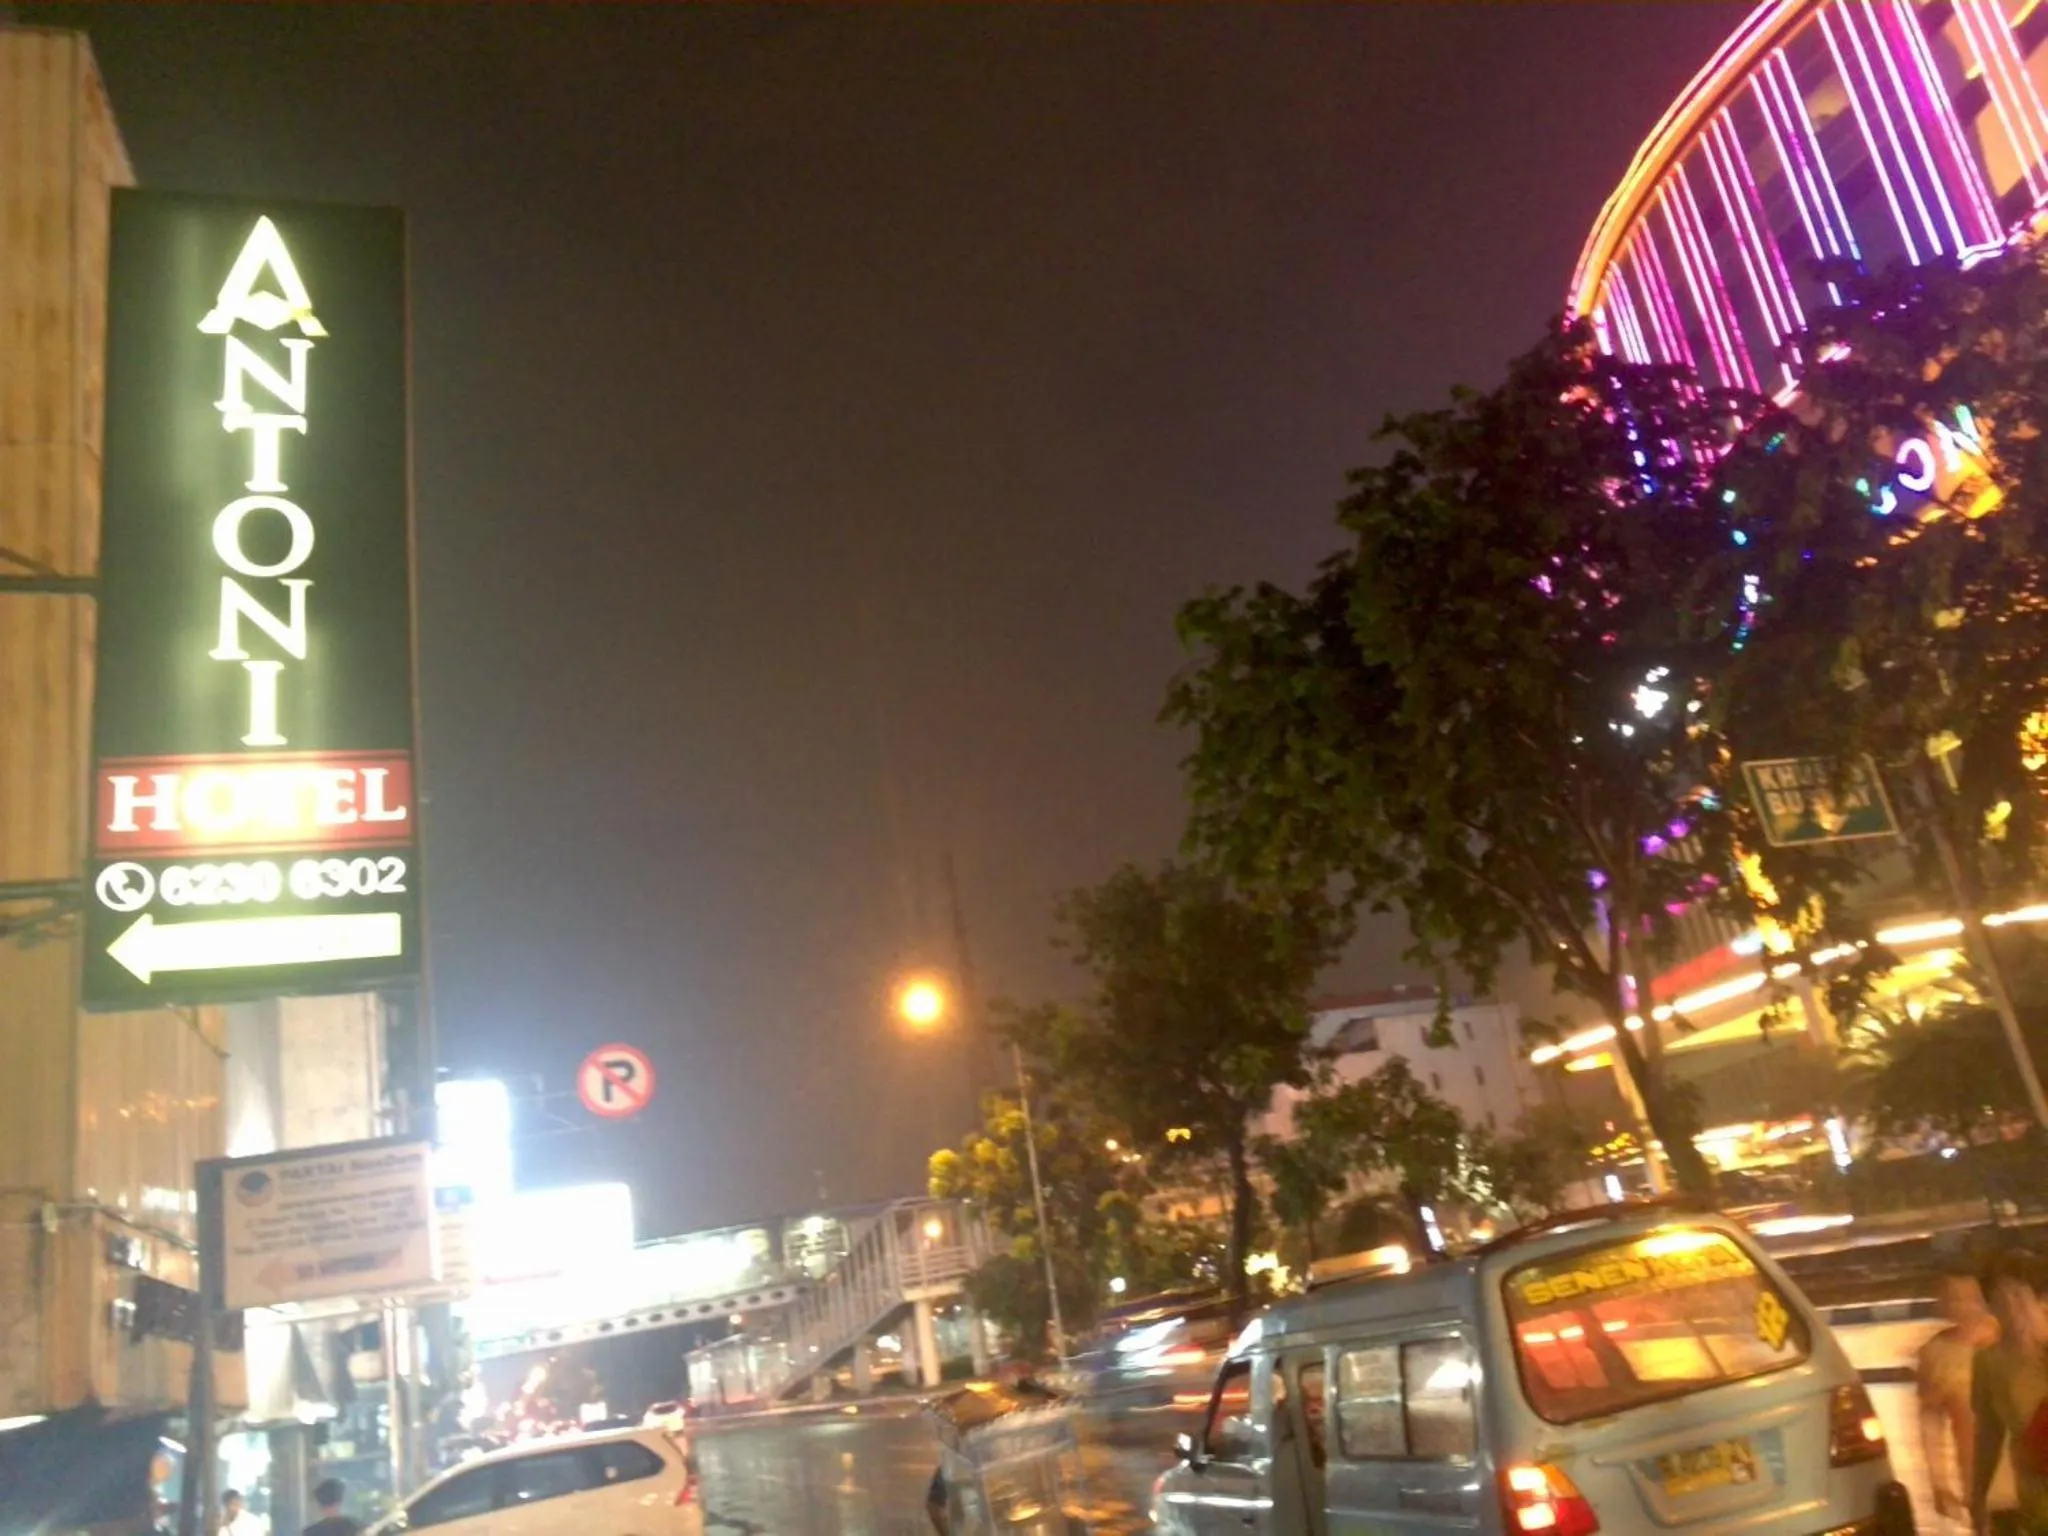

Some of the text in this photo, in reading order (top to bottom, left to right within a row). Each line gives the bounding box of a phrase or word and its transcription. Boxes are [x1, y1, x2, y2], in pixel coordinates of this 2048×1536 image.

[196, 214, 329, 746] ANTONI
[107, 767, 407, 832] HOTEL
[290, 856, 407, 900] 6302
[601, 1059, 637, 1104] P
[1522, 1257, 1650, 1305] SENEN
